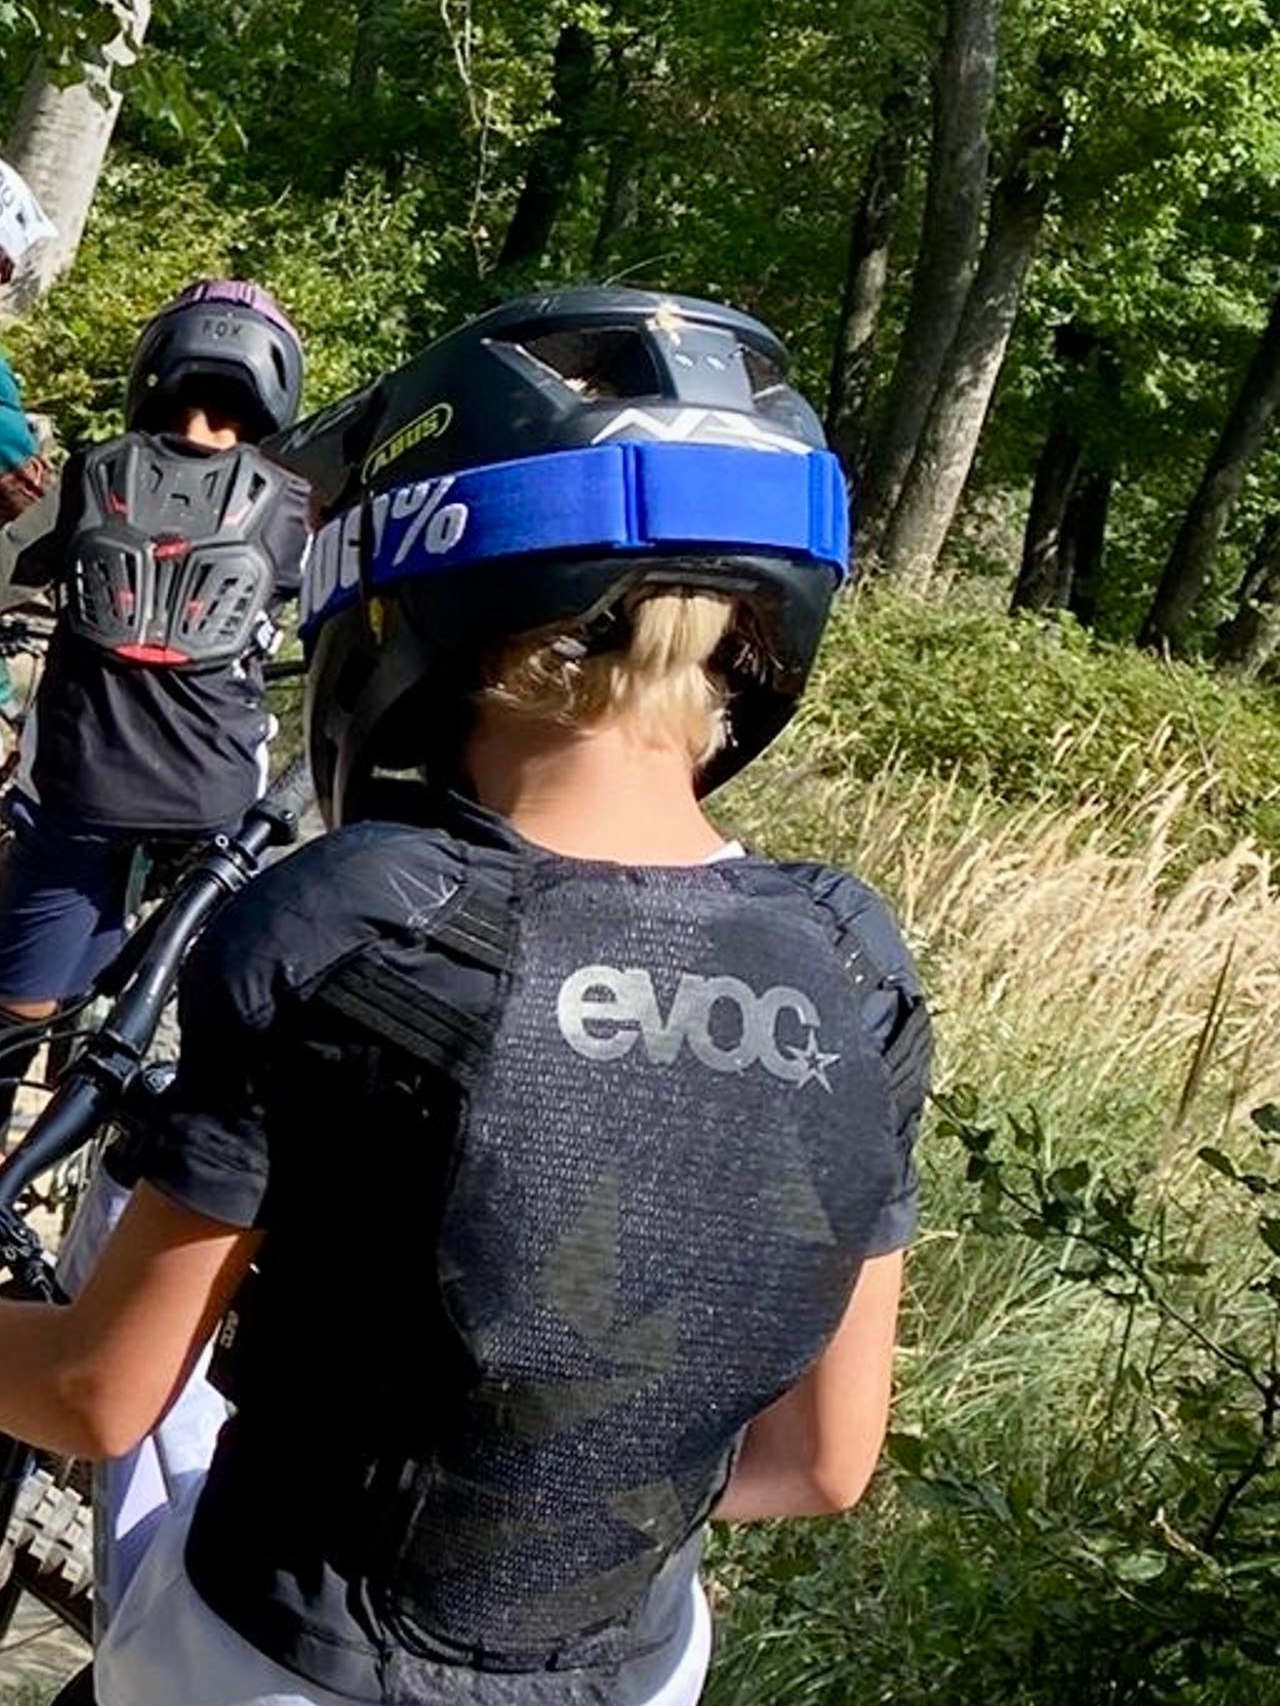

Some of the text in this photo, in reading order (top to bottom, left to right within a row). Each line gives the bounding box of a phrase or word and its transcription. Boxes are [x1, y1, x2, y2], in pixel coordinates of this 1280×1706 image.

[202, 319, 244, 337] FOX
[370, 412, 439, 477] ABUS
[557, 964, 830, 1089] evoc
